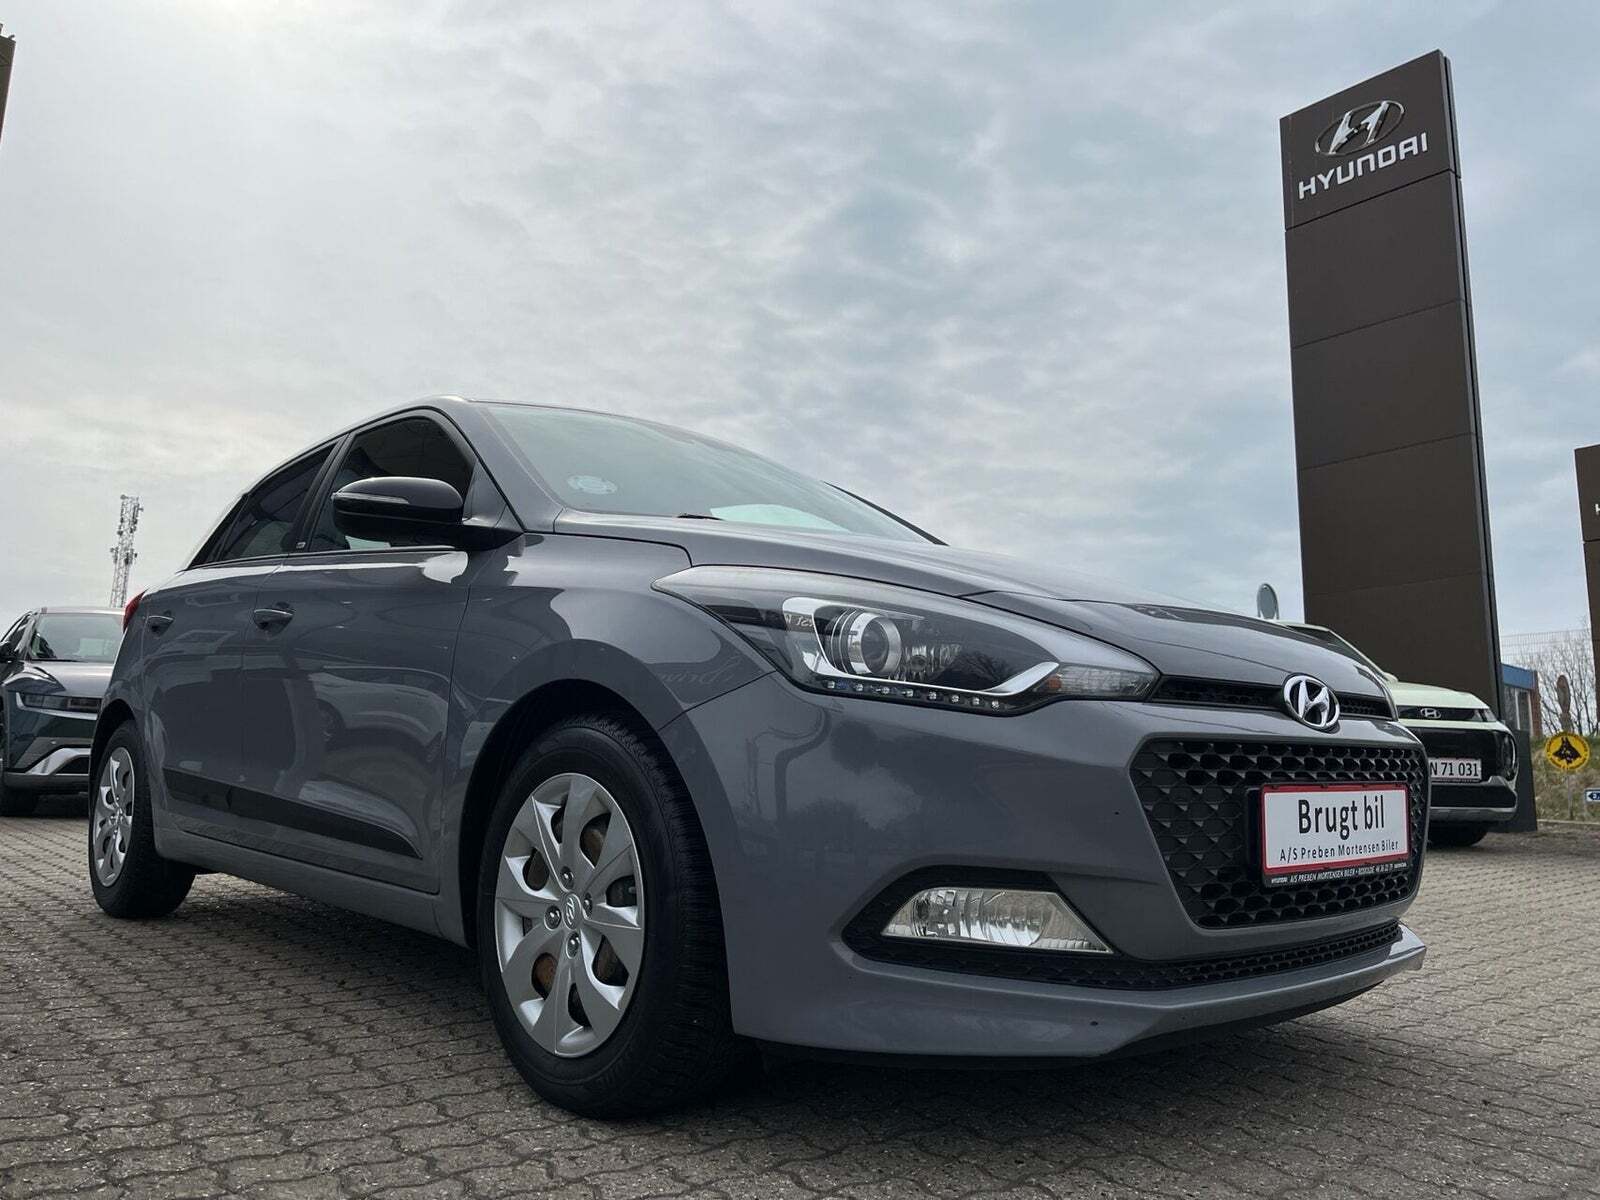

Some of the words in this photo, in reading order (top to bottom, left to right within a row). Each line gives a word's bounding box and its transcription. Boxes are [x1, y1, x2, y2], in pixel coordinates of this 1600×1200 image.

[1298, 132, 1428, 199] HYUNDAI
[1440, 762, 1454, 776] 71
[1458, 762, 1479, 777] 031
[1298, 799, 1358, 841] Brugt
[1364, 795, 1385, 830] bil
[1280, 847, 1298, 864] A/S
[1301, 847, 1335, 860] Preben
[1338, 843, 1380, 857] Mortensen
[1381, 840, 1399, 852] Biler
